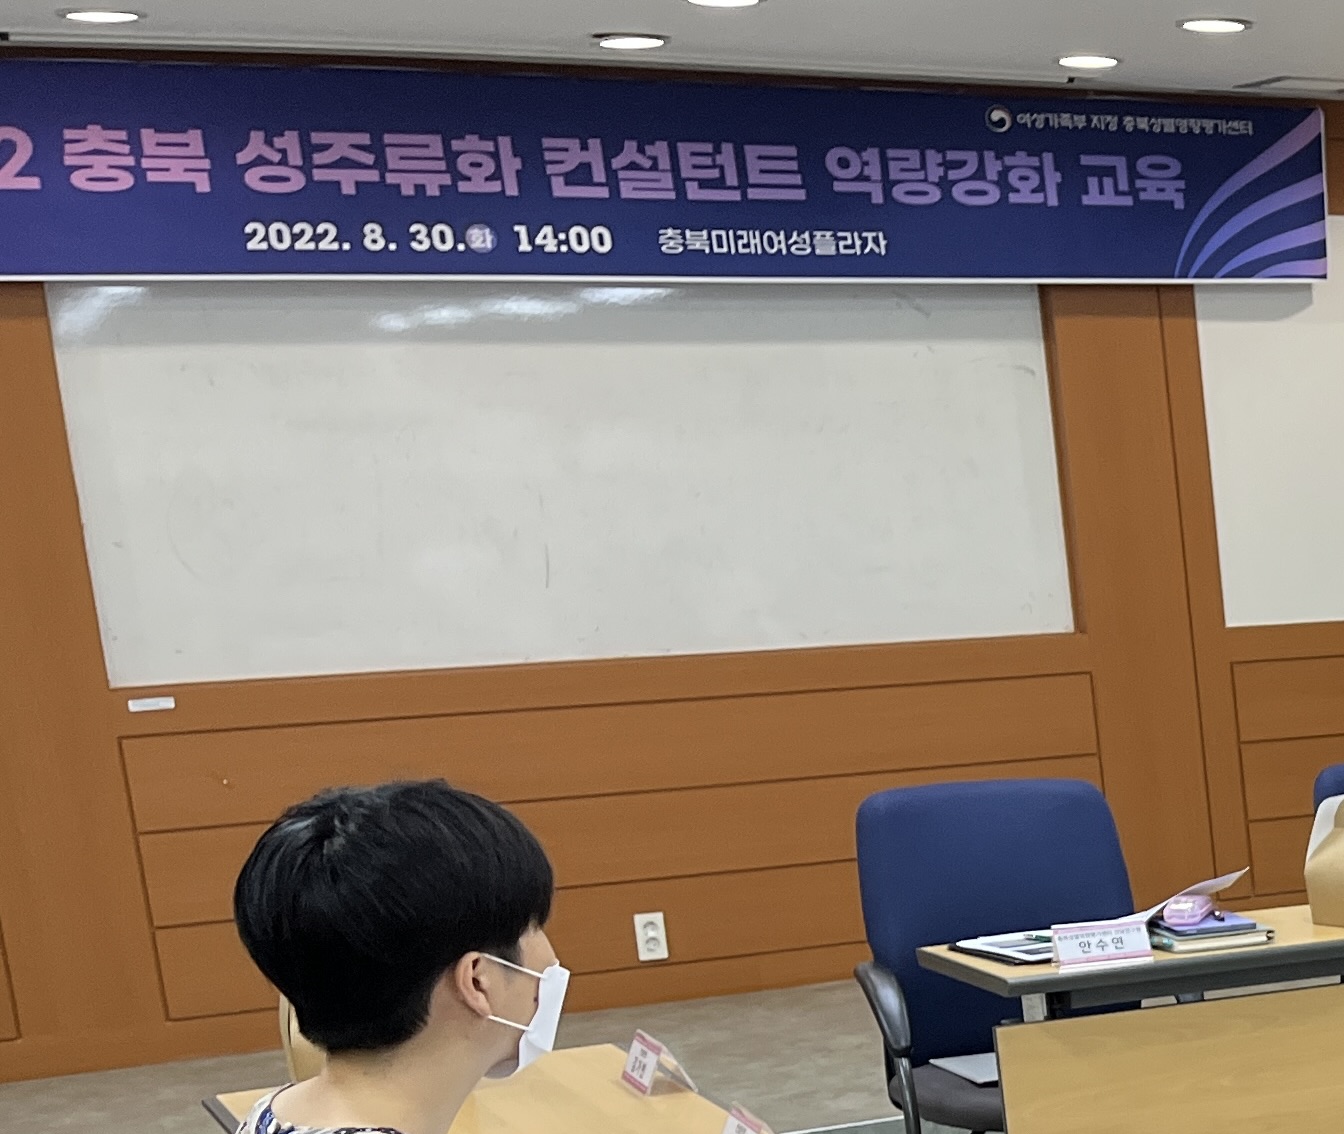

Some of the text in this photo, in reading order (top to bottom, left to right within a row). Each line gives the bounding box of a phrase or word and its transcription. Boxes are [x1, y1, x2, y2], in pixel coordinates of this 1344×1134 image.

[63, 124, 211, 193] 충북
[235, 129, 521, 198] 성주류화
[541, 136, 807, 203] 컨설턴트
[825, 143, 1061, 208] 역량강화
[1079, 151, 1186, 210] 교육
[244, 221, 351, 251] 2022.
[363, 223, 397, 251] 8.
[513, 224, 613, 254] 14:00
[657, 227, 888, 257] 충북미래여성플라자
